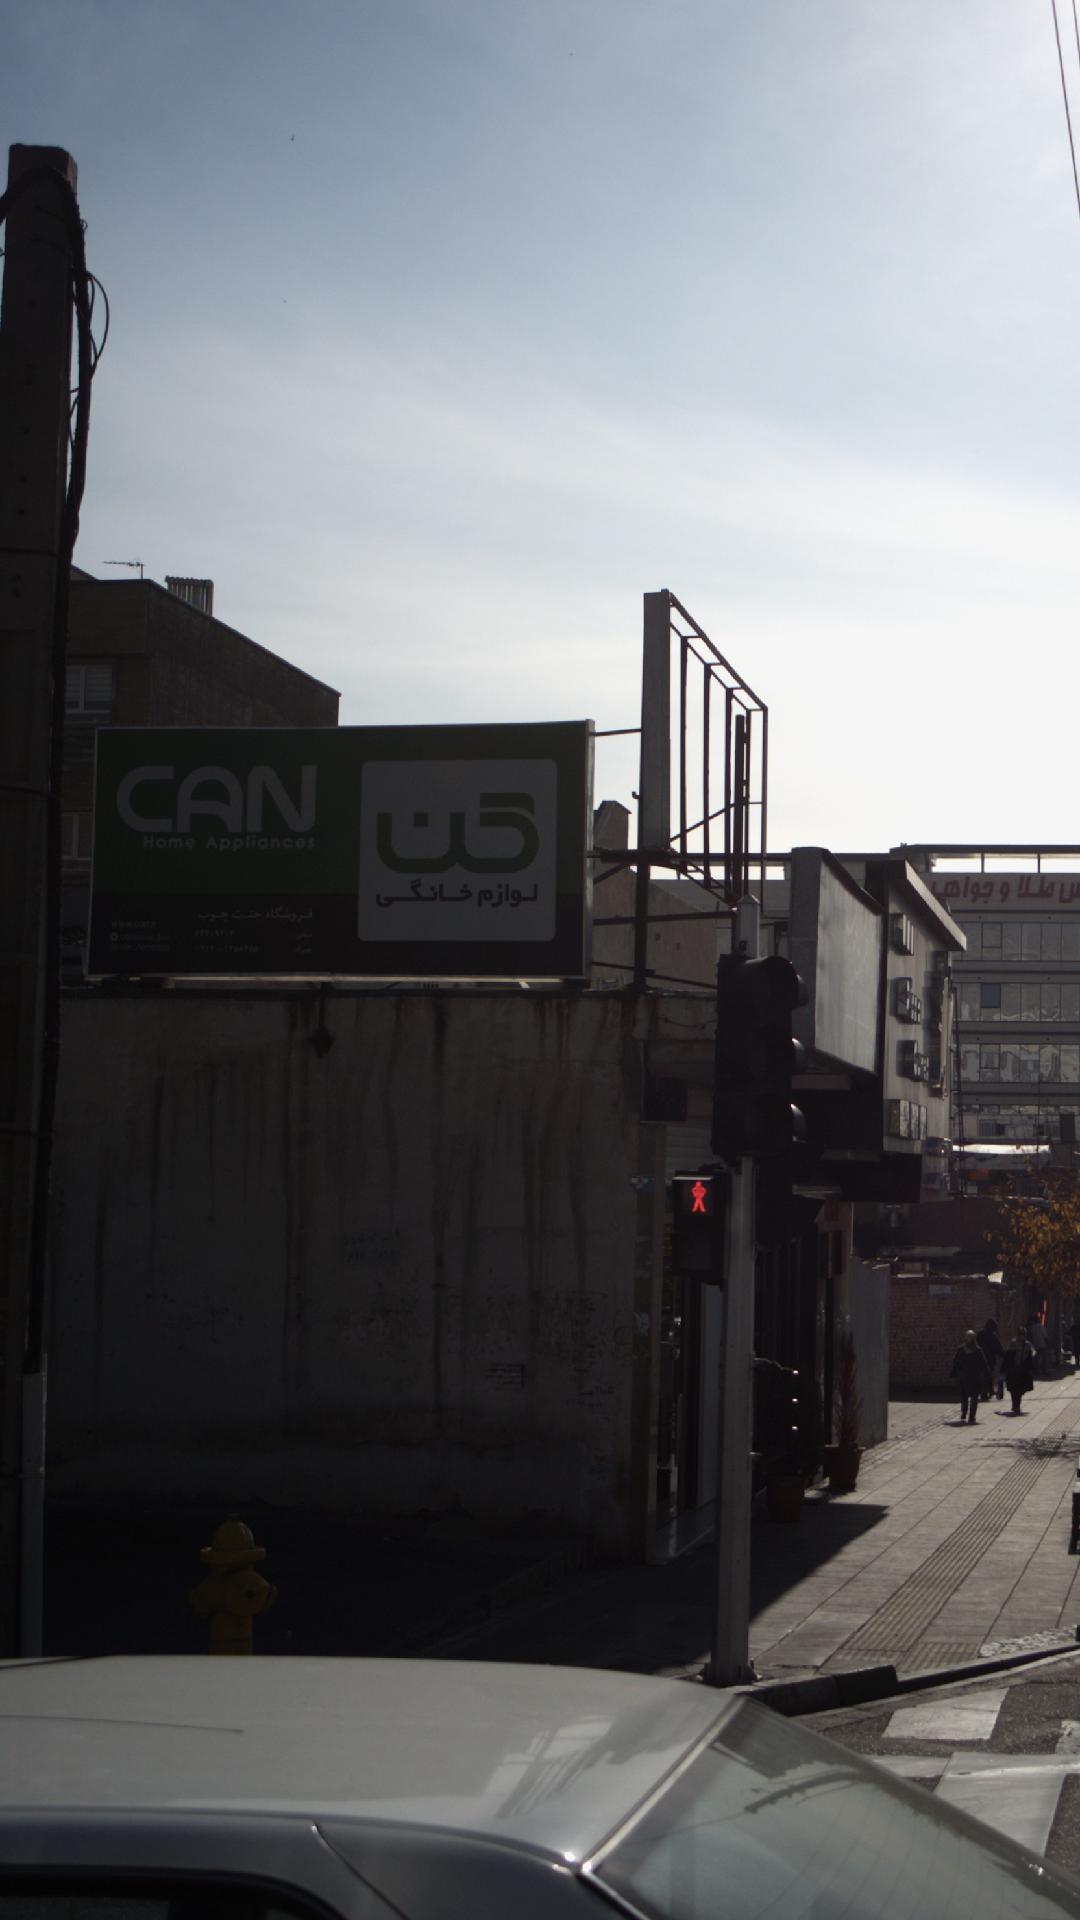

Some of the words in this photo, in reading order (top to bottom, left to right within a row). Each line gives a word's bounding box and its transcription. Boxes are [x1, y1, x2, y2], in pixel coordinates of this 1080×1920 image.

[116, 765, 318, 834] CAN
[143, 834, 196, 849] Home
[205, 833, 317, 852] Appliances
[376, 792, 540, 874] کن
[375, 878, 473, 908] خانگی
[477, 883, 539, 908] لوازم
[999, 880, 1011, 904] و
[1017, 876, 1055, 898] طلا
